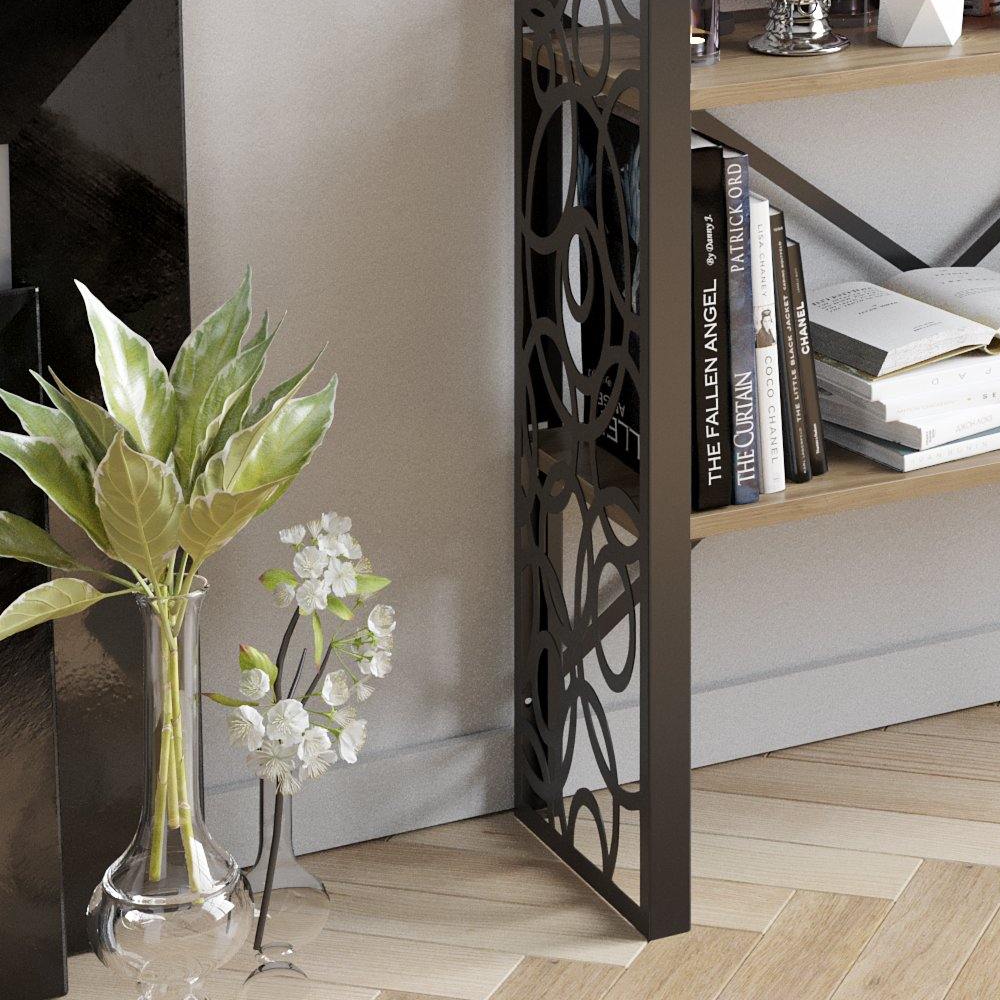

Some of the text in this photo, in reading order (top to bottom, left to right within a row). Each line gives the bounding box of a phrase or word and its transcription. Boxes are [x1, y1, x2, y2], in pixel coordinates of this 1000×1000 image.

[705, 224, 715, 252] Danny
[706, 252, 716, 266] By
[727, 162, 745, 273] PATRICK ORD
[756, 223, 765, 247] LISA
[703, 279, 722, 486] THE FALLEN ANGEL
[782, 295, 803, 423] THE LITTLE BLACK JACKET
[795, 301, 811, 355] CHANEL
[733, 371, 755, 486] THE CURTAIN
[764, 355, 780, 464] COCO CHANEL
